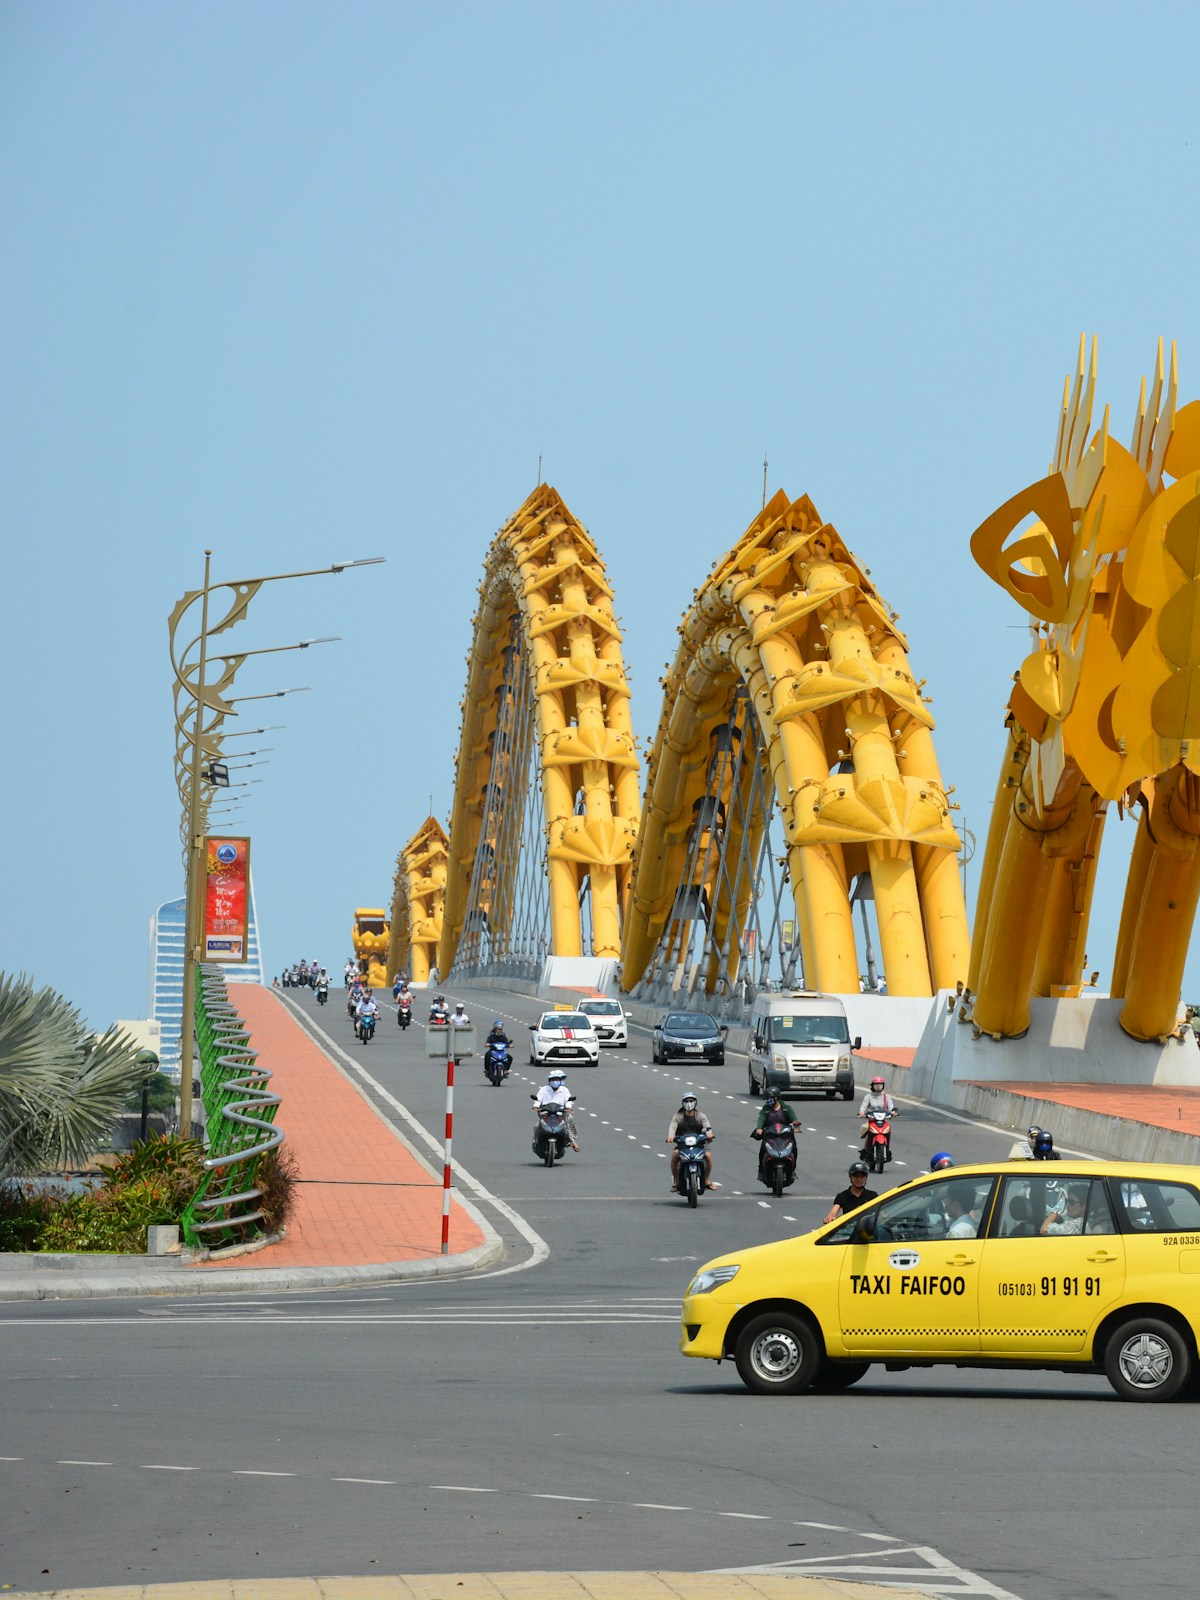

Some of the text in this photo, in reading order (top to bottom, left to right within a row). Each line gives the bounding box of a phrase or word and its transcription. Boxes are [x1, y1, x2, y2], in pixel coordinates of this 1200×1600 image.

[1163, 1237, 1178, 1245] 92A
[850, 1275, 965, 1295] TAXI FAIFOO
[998, 1277, 1100, 1296] (05103) 91 91 91
